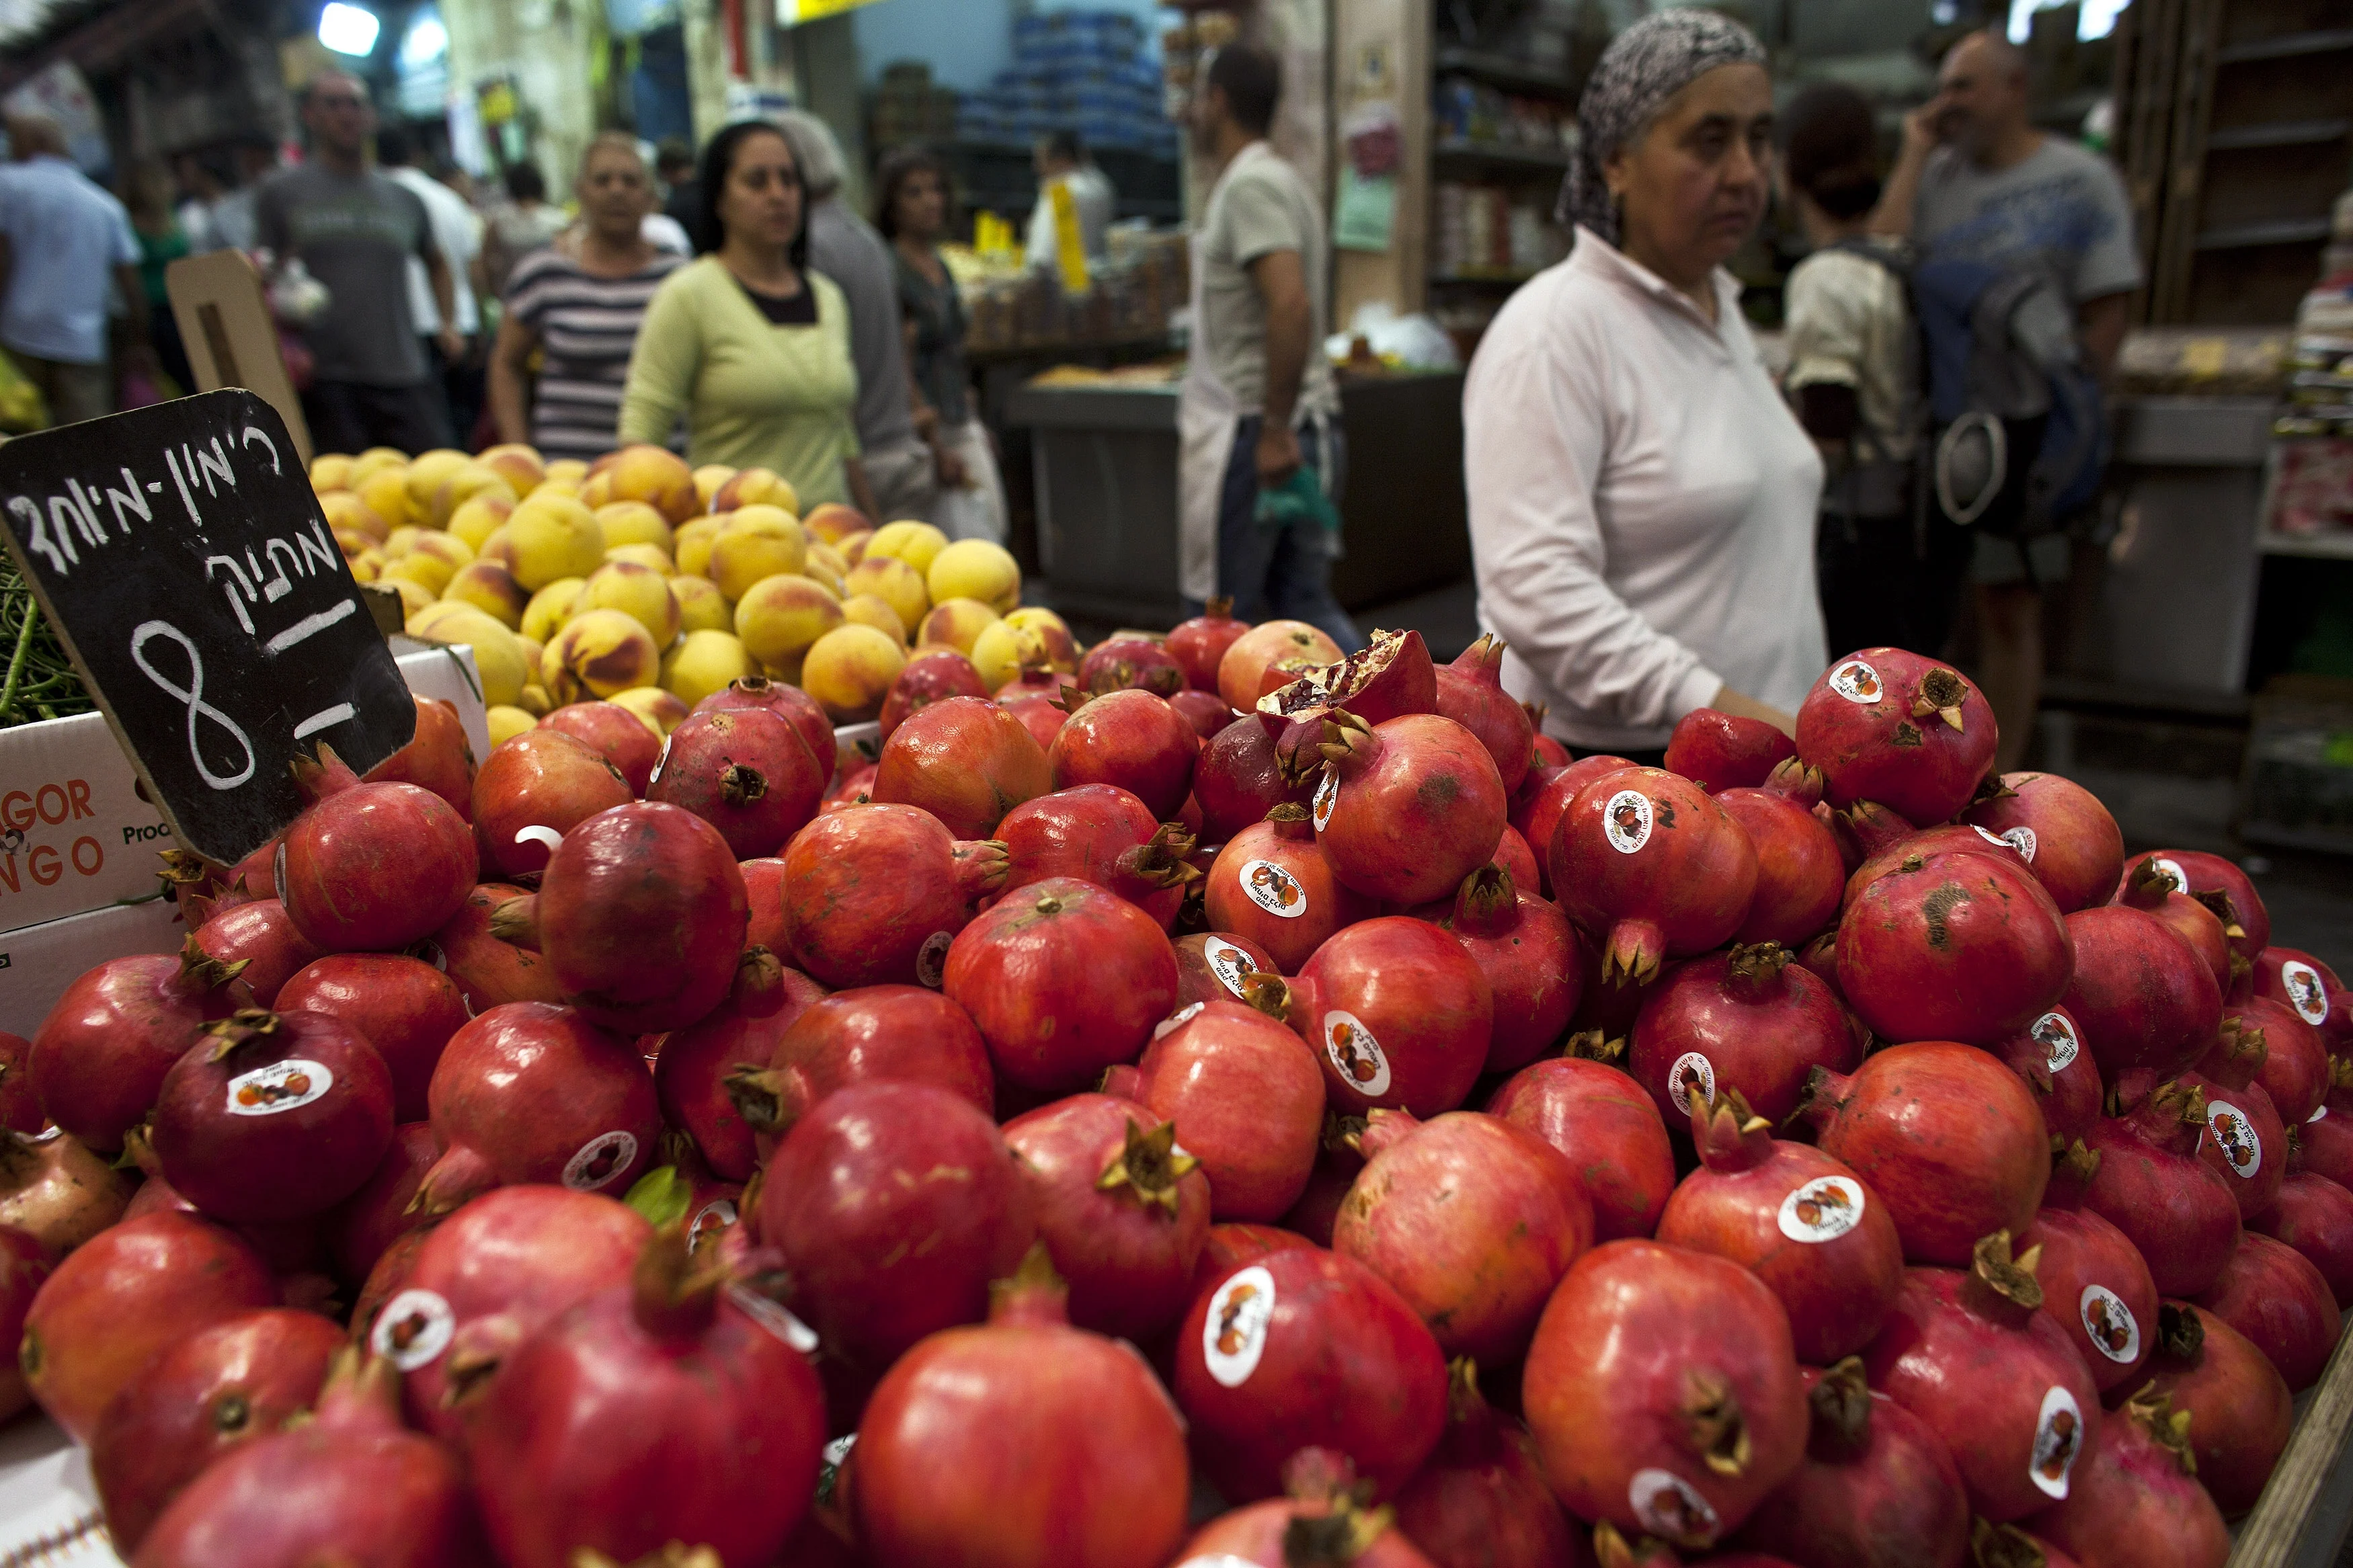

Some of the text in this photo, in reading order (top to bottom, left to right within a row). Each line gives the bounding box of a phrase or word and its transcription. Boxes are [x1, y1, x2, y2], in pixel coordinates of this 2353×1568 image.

[0, 779, 95, 835] GOR
[1632, 794, 1645, 807] בלום
[1632, 831, 1646, 848] משק
[1250, 882, 1286, 910] האחים בלום
[1256, 897, 1271, 908] משק
[1214, 954, 1243, 991] האחים בלום
[1216, 967, 1229, 981] משק
[2051, 1046, 2069, 1063] האחים
[2066, 1048, 2076, 1061] משק
[1673, 1055, 1693, 1110] משק האחים בלום
[2230, 1114, 2255, 1157] האחים בלום
[2245, 1124, 2256, 1139] משק
